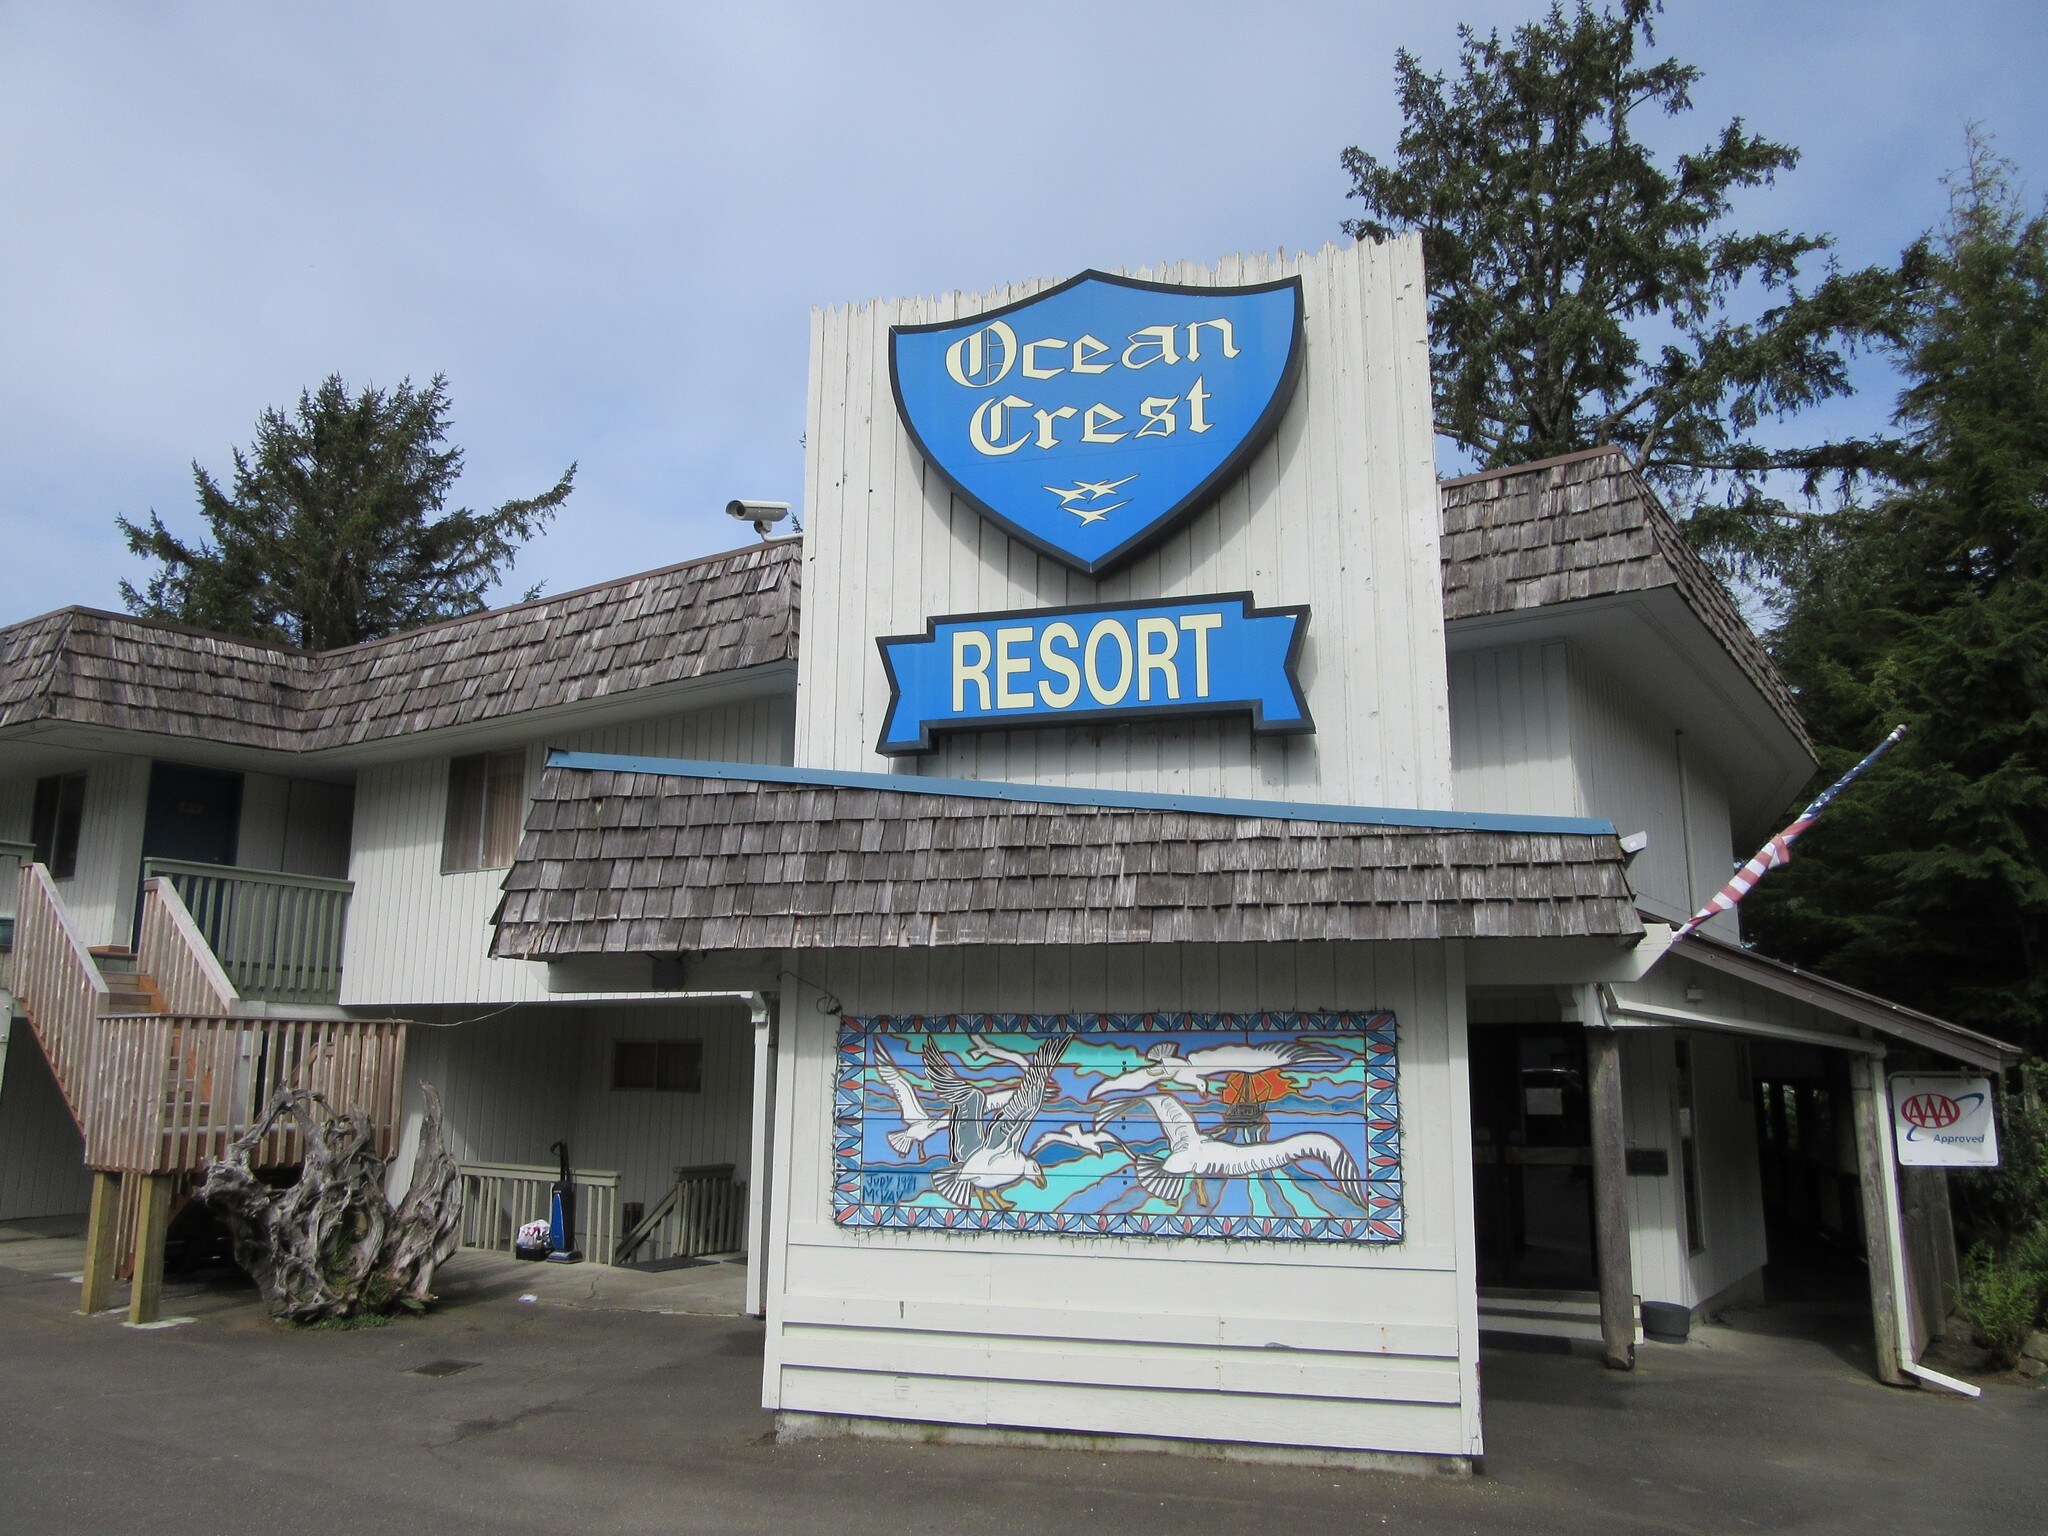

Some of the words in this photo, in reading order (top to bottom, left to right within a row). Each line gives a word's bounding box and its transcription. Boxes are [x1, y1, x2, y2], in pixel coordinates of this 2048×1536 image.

[945, 319, 1241, 388] Ocean
[968, 374, 1215, 456] Crest
[951, 613, 1222, 712] RESORT
[1908, 1094, 1956, 1127] AAA
[1933, 1134, 1984, 1144] Approved
